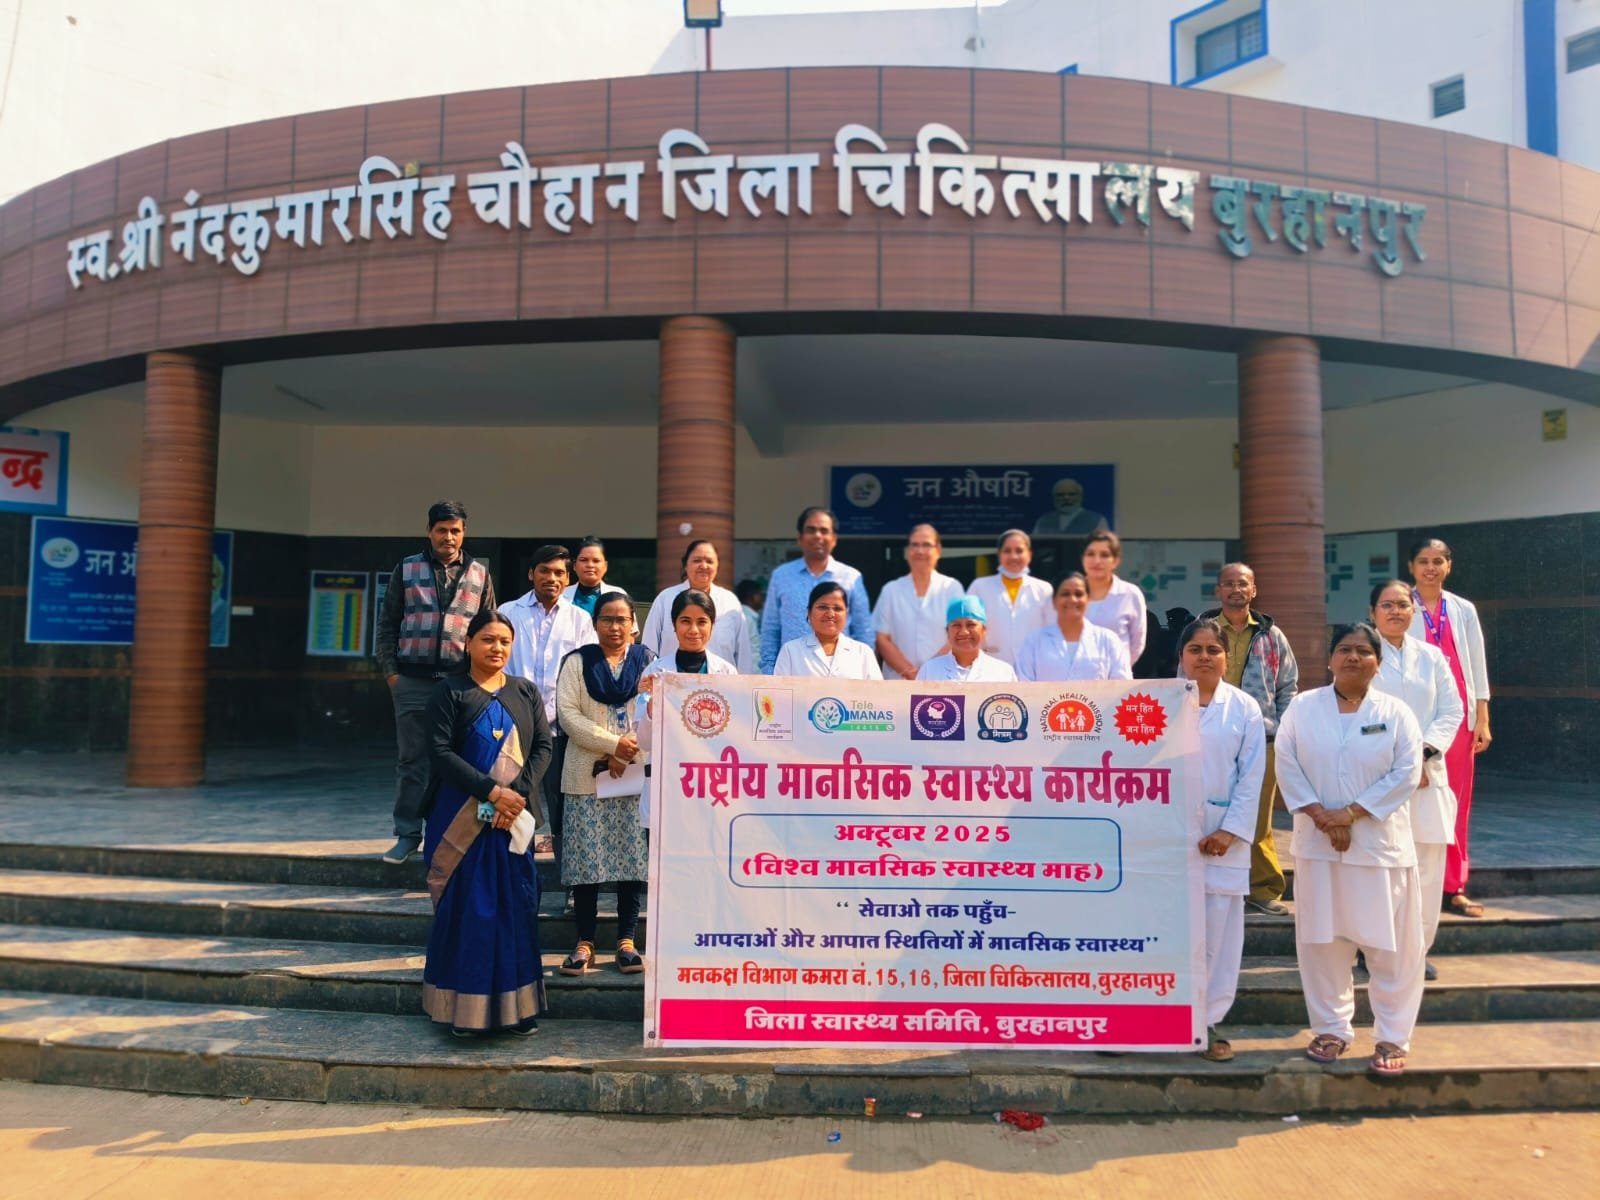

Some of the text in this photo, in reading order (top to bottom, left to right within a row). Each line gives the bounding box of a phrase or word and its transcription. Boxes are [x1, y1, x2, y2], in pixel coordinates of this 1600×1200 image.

[171, 155, 456, 275] नंदकुमारसिंह
[467, 141, 645, 233] चौहान
[658, 128, 820, 220] जिला
[833, 123, 1200, 232] चिकित्सालय
[1210, 173, 1427, 276] बुरहानपुर
[0, 446, 49, 491] न्द्र
[904, 476, 943, 497] जन
[952, 470, 1033, 498] औषधि
[84, 549, 116, 576] जन
[850, 710, 893, 720] MANAS
[851, 700, 873, 710] Tele
[1040, 698, 1058, 733] NATIONAL
[1059, 693, 1089, 702] HEALTH
[1088, 701, 1103, 734] MISSION
[1126, 703, 1154, 713] मन हित
[1126, 724, 1155, 735] जन हित
[679, 746, 1171, 808] राष्ट्रीय मानसिक स्वास्थ्य कार्यक्रम
[834, 825, 1010, 848] अक्टूबर 2025
[742, 852, 1104, 882] (विश्व मानसिक स्वास्थ्य माह)
[859, 898, 920, 918] सेवाओ
[926, 904, 959, 918] तक
[694, 927, 777, 947] आपदाओं
[781, 928, 815, 948] और
[820, 934, 880, 949] आपात
[885, 930, 964, 950] स्थितियों
[968, 930, 985, 950] में
[988, 932, 1070, 952] मानसिक
[677, 967, 738, 986] मनकक्ष
[743, 961, 798, 985] विभाग
[802, 968, 848, 985] कमरा
[943, 963, 986, 987] जिला
[744, 1006, 1108, 1039] जिला स्वास्थ्य समिति, बुरहानपुर
